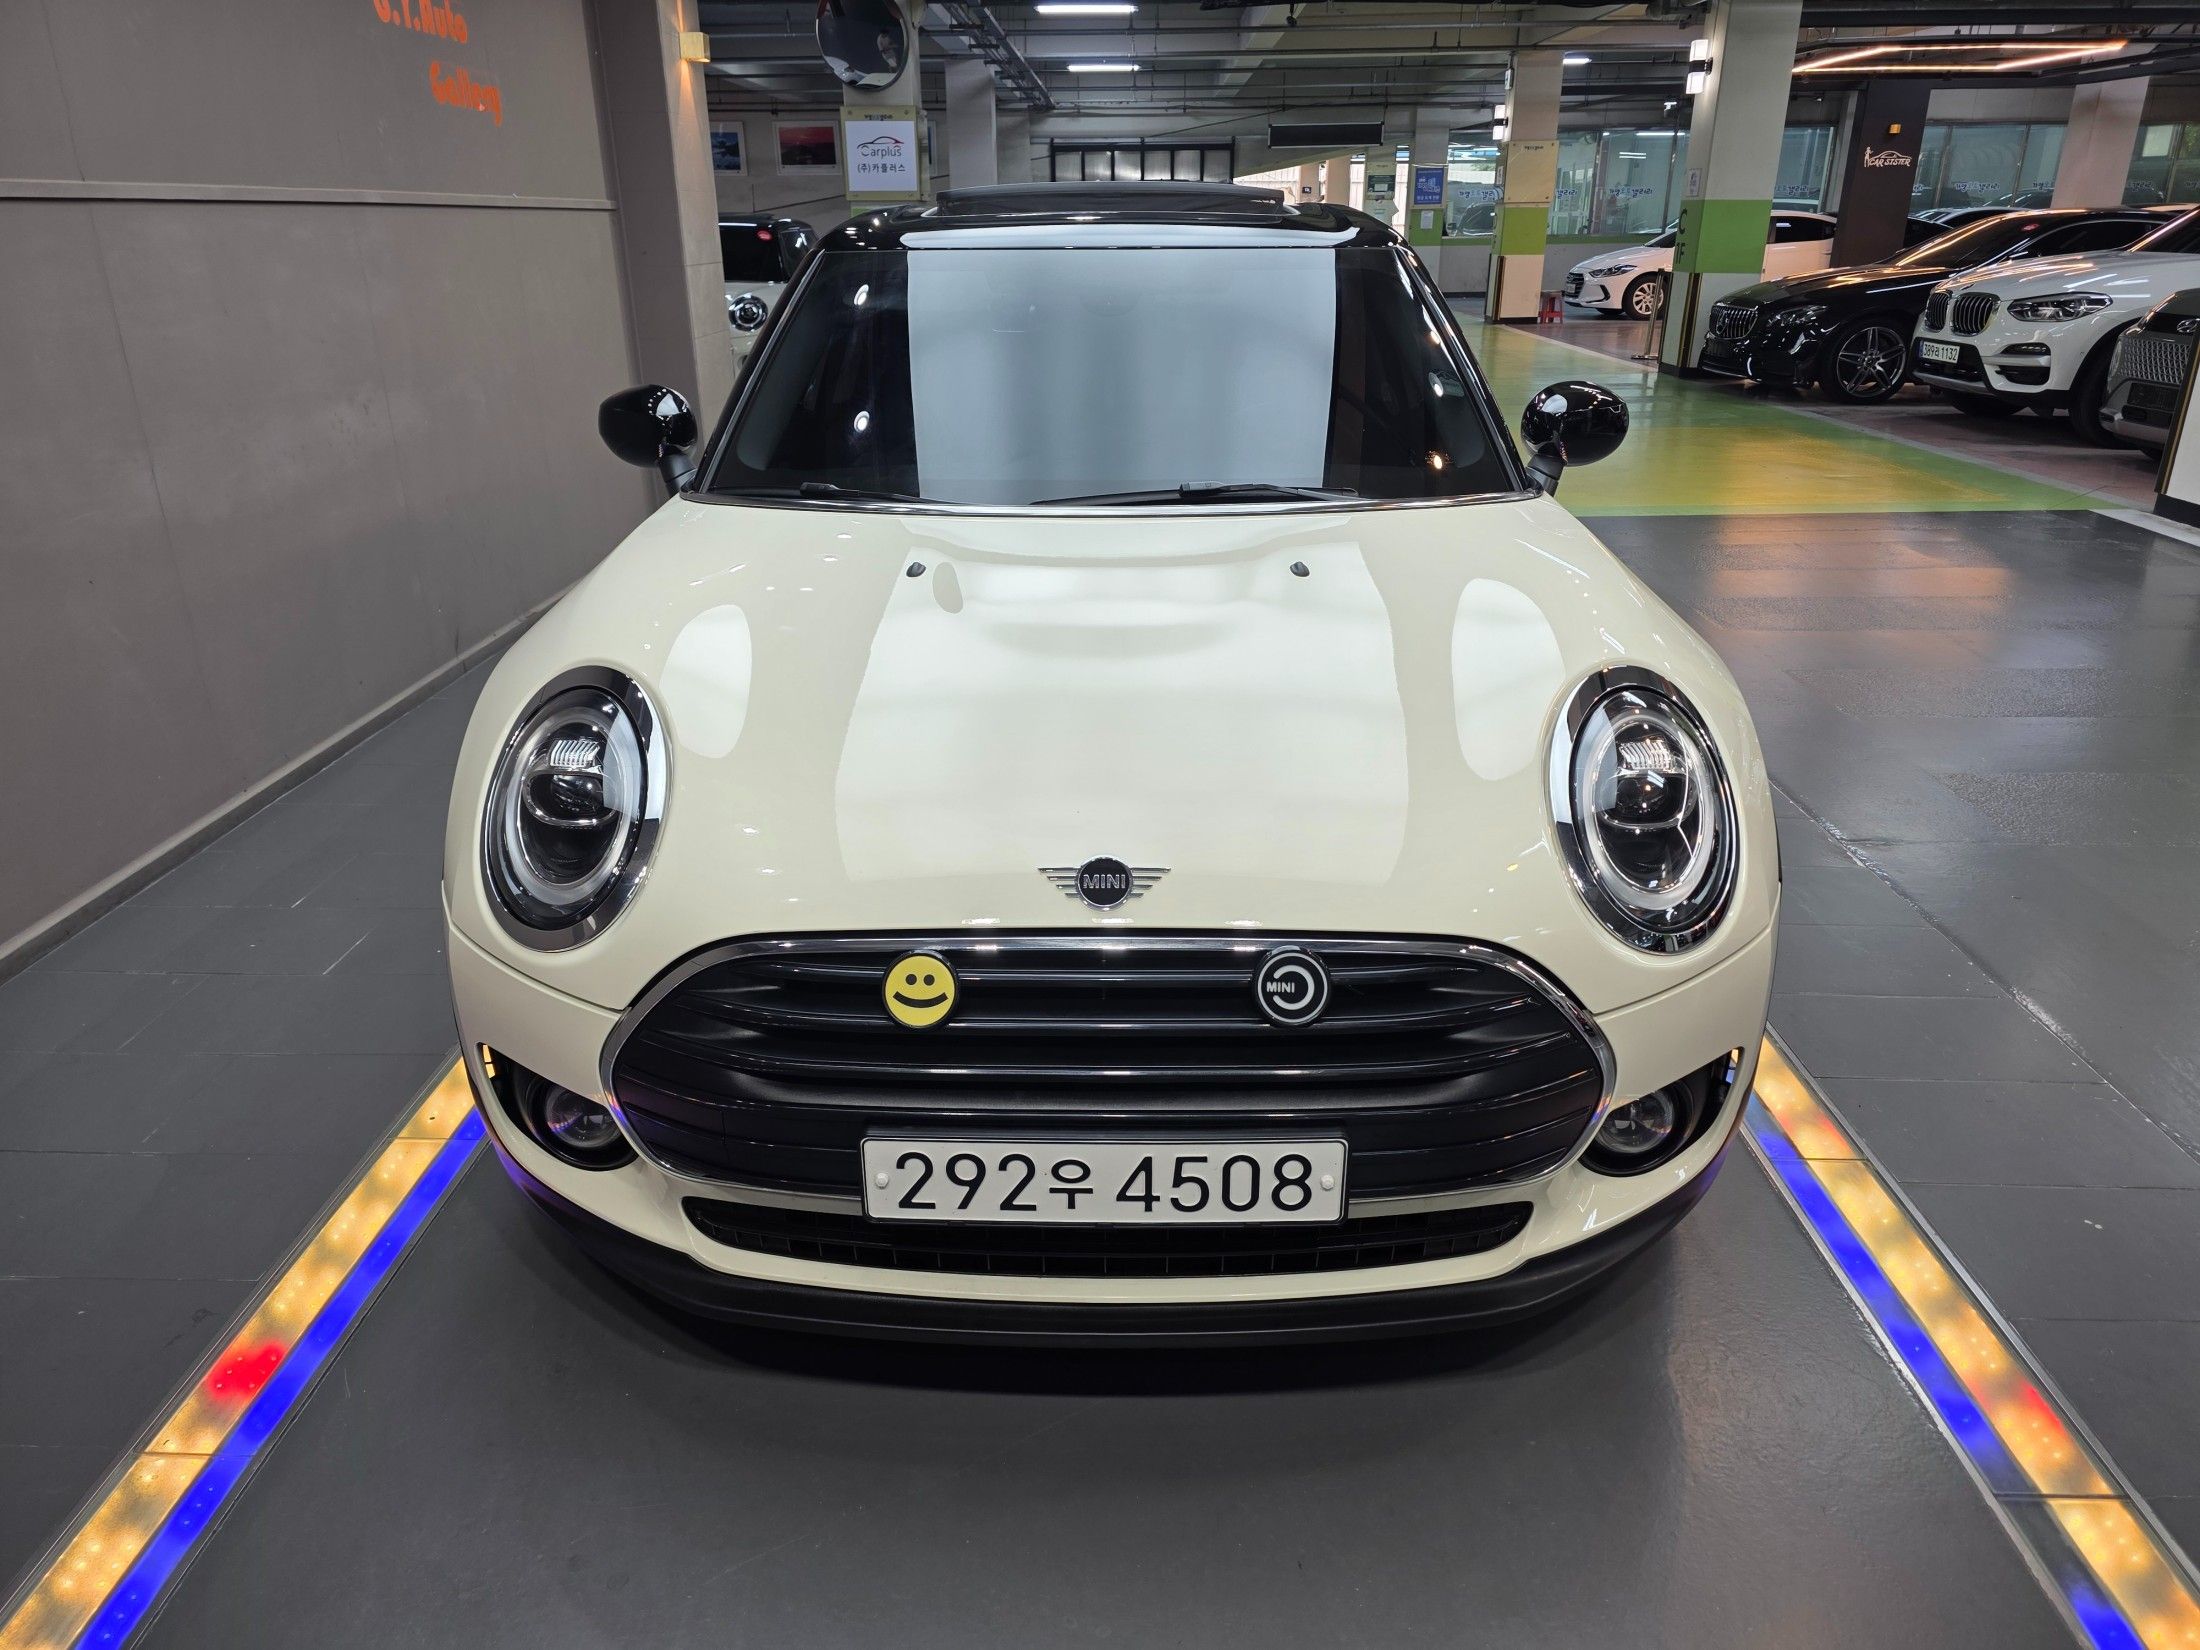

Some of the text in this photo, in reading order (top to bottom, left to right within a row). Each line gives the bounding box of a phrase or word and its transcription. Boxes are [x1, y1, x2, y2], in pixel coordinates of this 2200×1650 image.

[429, 60, 503, 127] Gallery
[861, 145, 902, 159] Carplus
[1870, 158, 1911, 167] CAR SISTER
[1941, 347, 1958, 360] 1132
[1083, 874, 1126, 889] MINI
[1266, 981, 1296, 993] MINI
[896, 1151, 1314, 1213] 292우 4508
